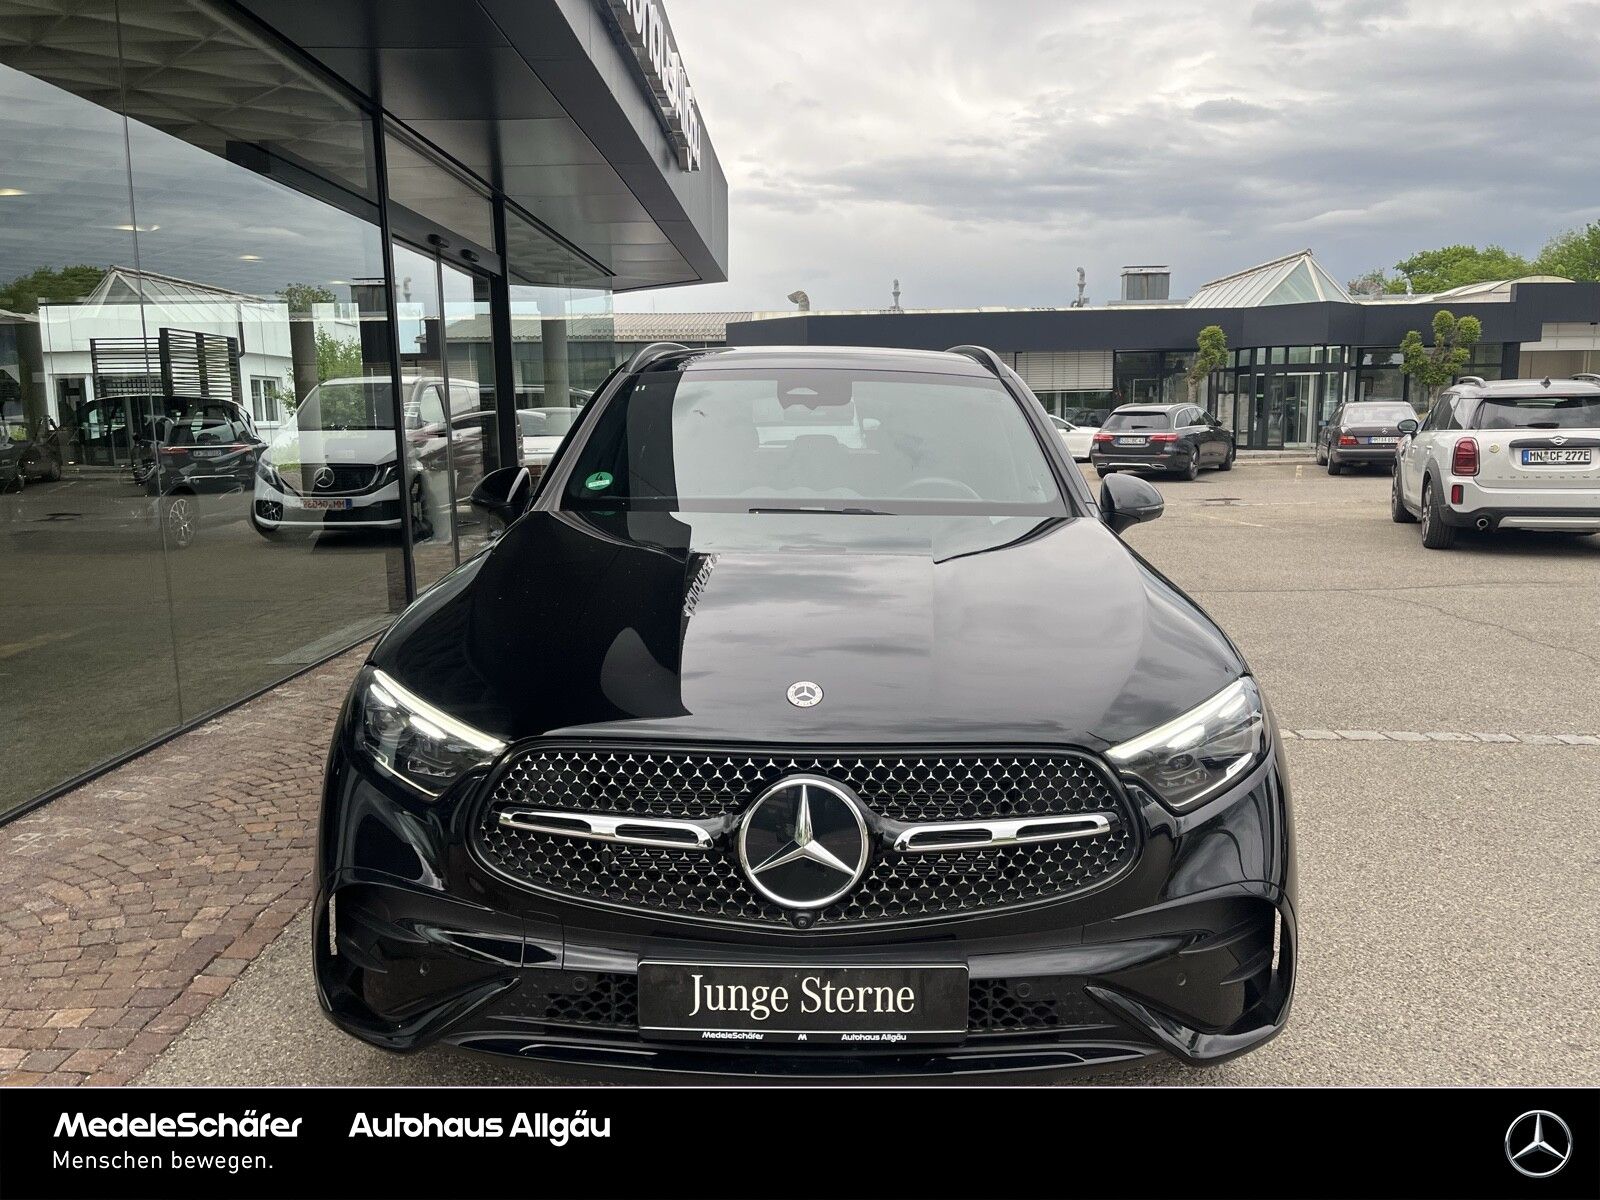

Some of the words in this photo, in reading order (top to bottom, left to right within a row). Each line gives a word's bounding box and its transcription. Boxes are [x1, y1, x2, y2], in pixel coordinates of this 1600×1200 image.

[1530, 451, 1543, 461] MN
[1550, 451, 1562, 461] CF
[1565, 450, 1590, 461] 277E
[689, 975, 788, 1020] Junge
[801, 977, 914, 1012] Sterne
[701, 1031, 764, 1040] MedeleSchäfer
[841, 1033, 880, 1041] Autohaus
[881, 1033, 907, 1042] Allgäu
